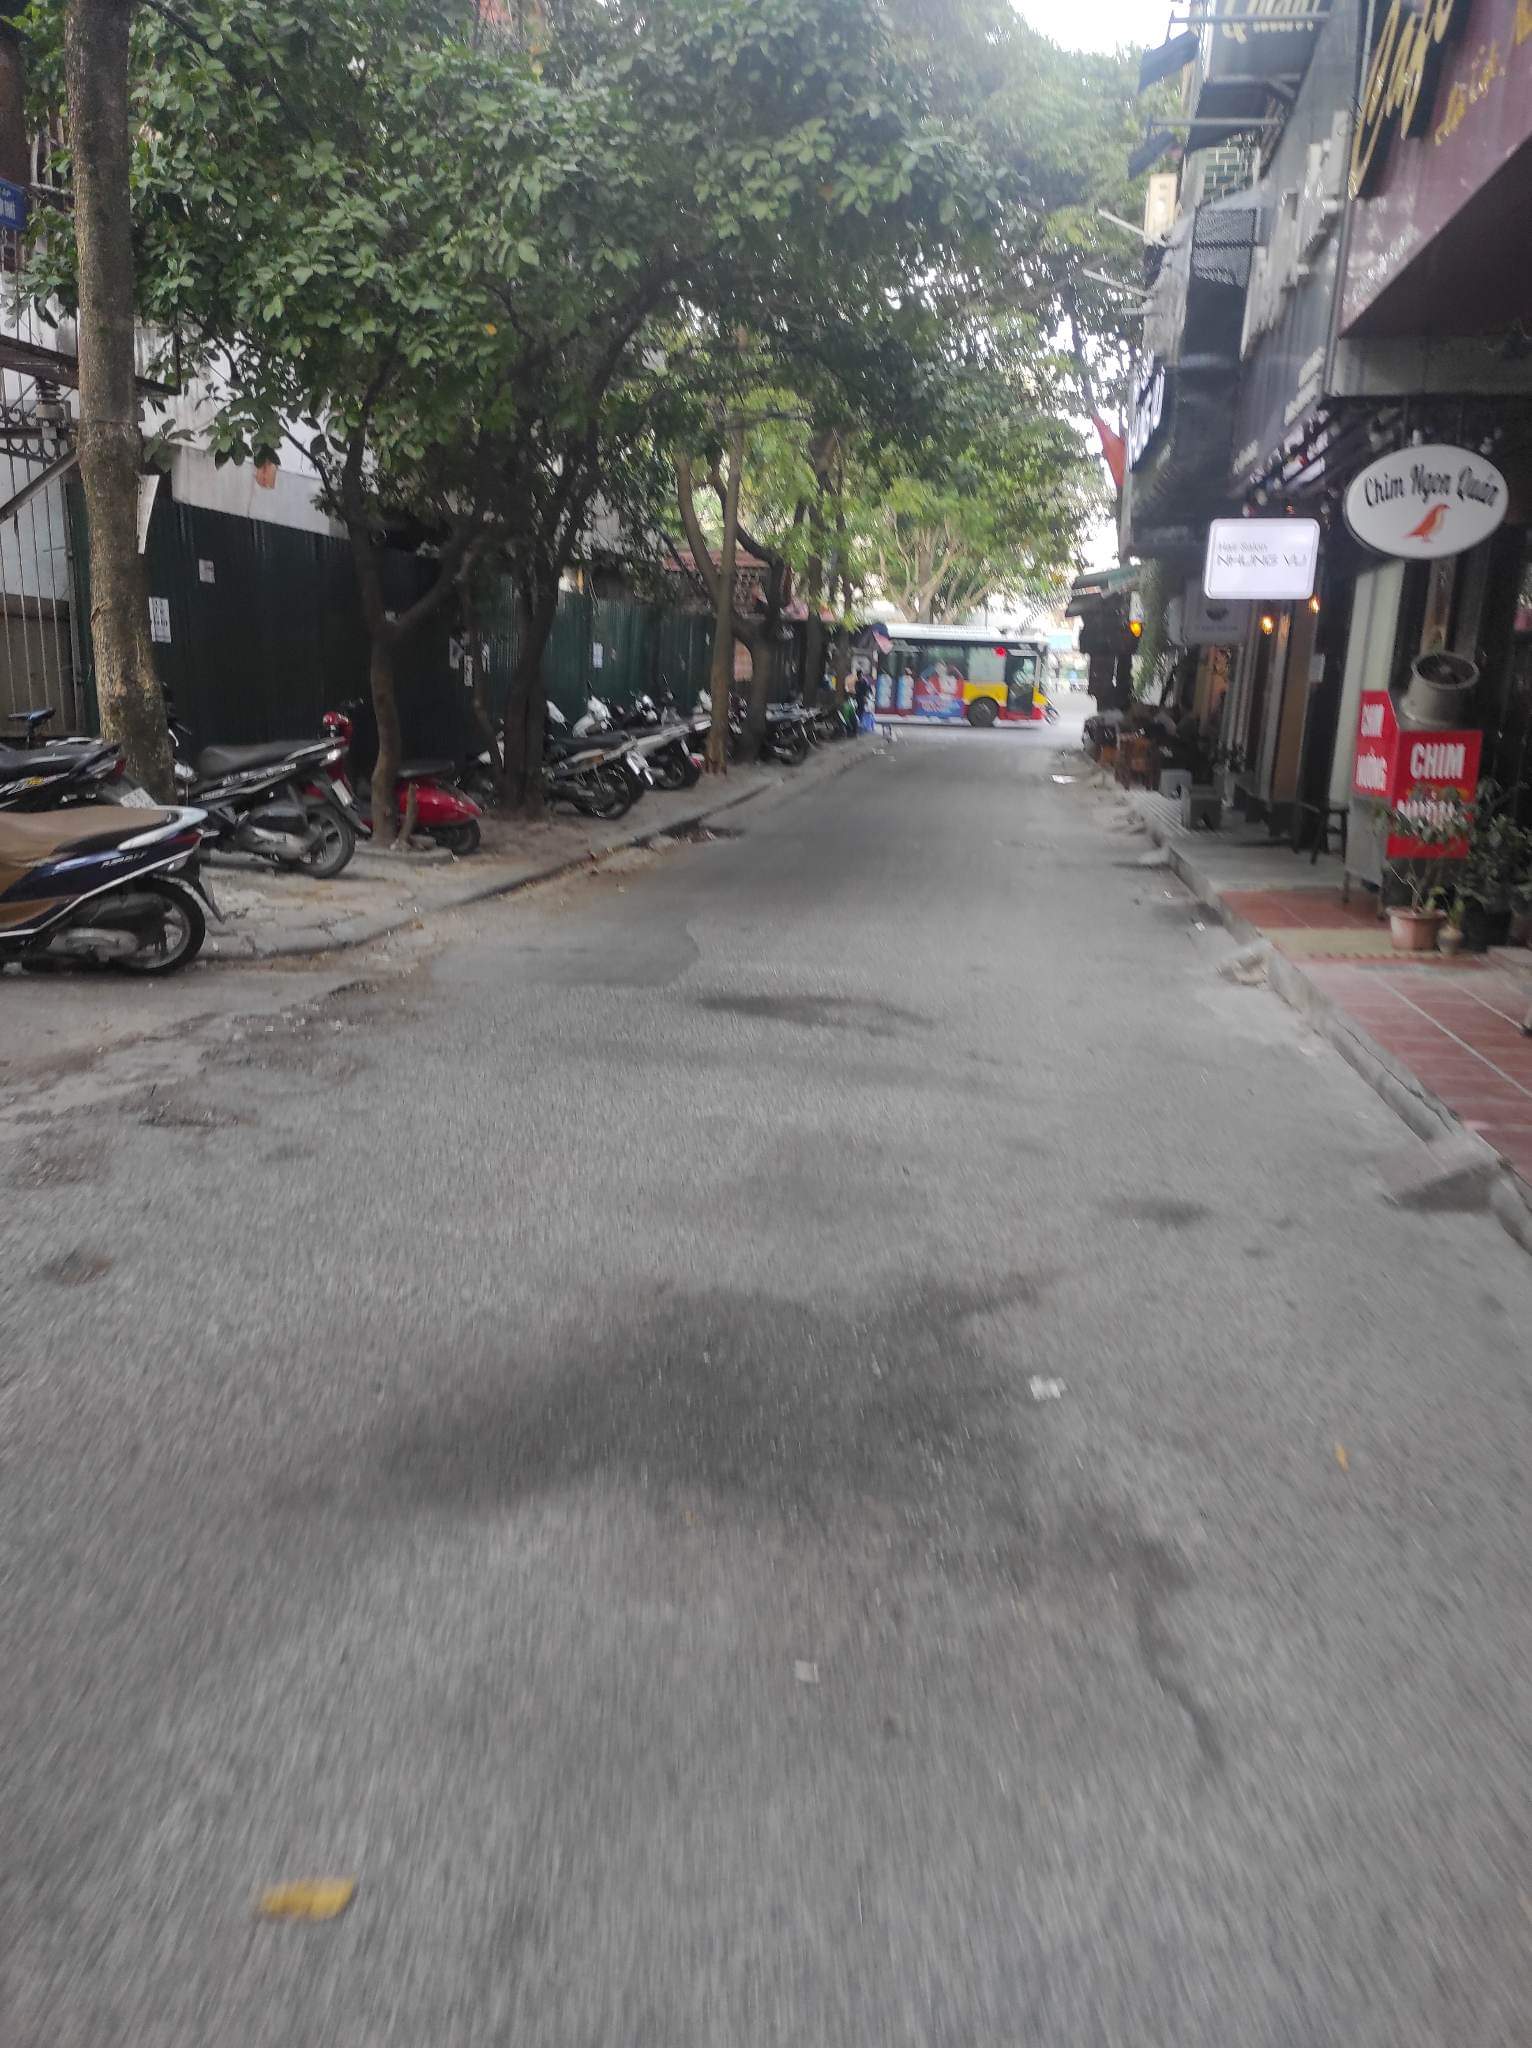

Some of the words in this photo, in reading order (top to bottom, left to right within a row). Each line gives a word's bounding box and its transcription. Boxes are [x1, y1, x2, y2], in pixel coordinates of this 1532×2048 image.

[1364, 471, 1404, 508] Chim
[1411, 463, 1451, 503] Ngon
[1410, 742, 1466, 780] CHIM
